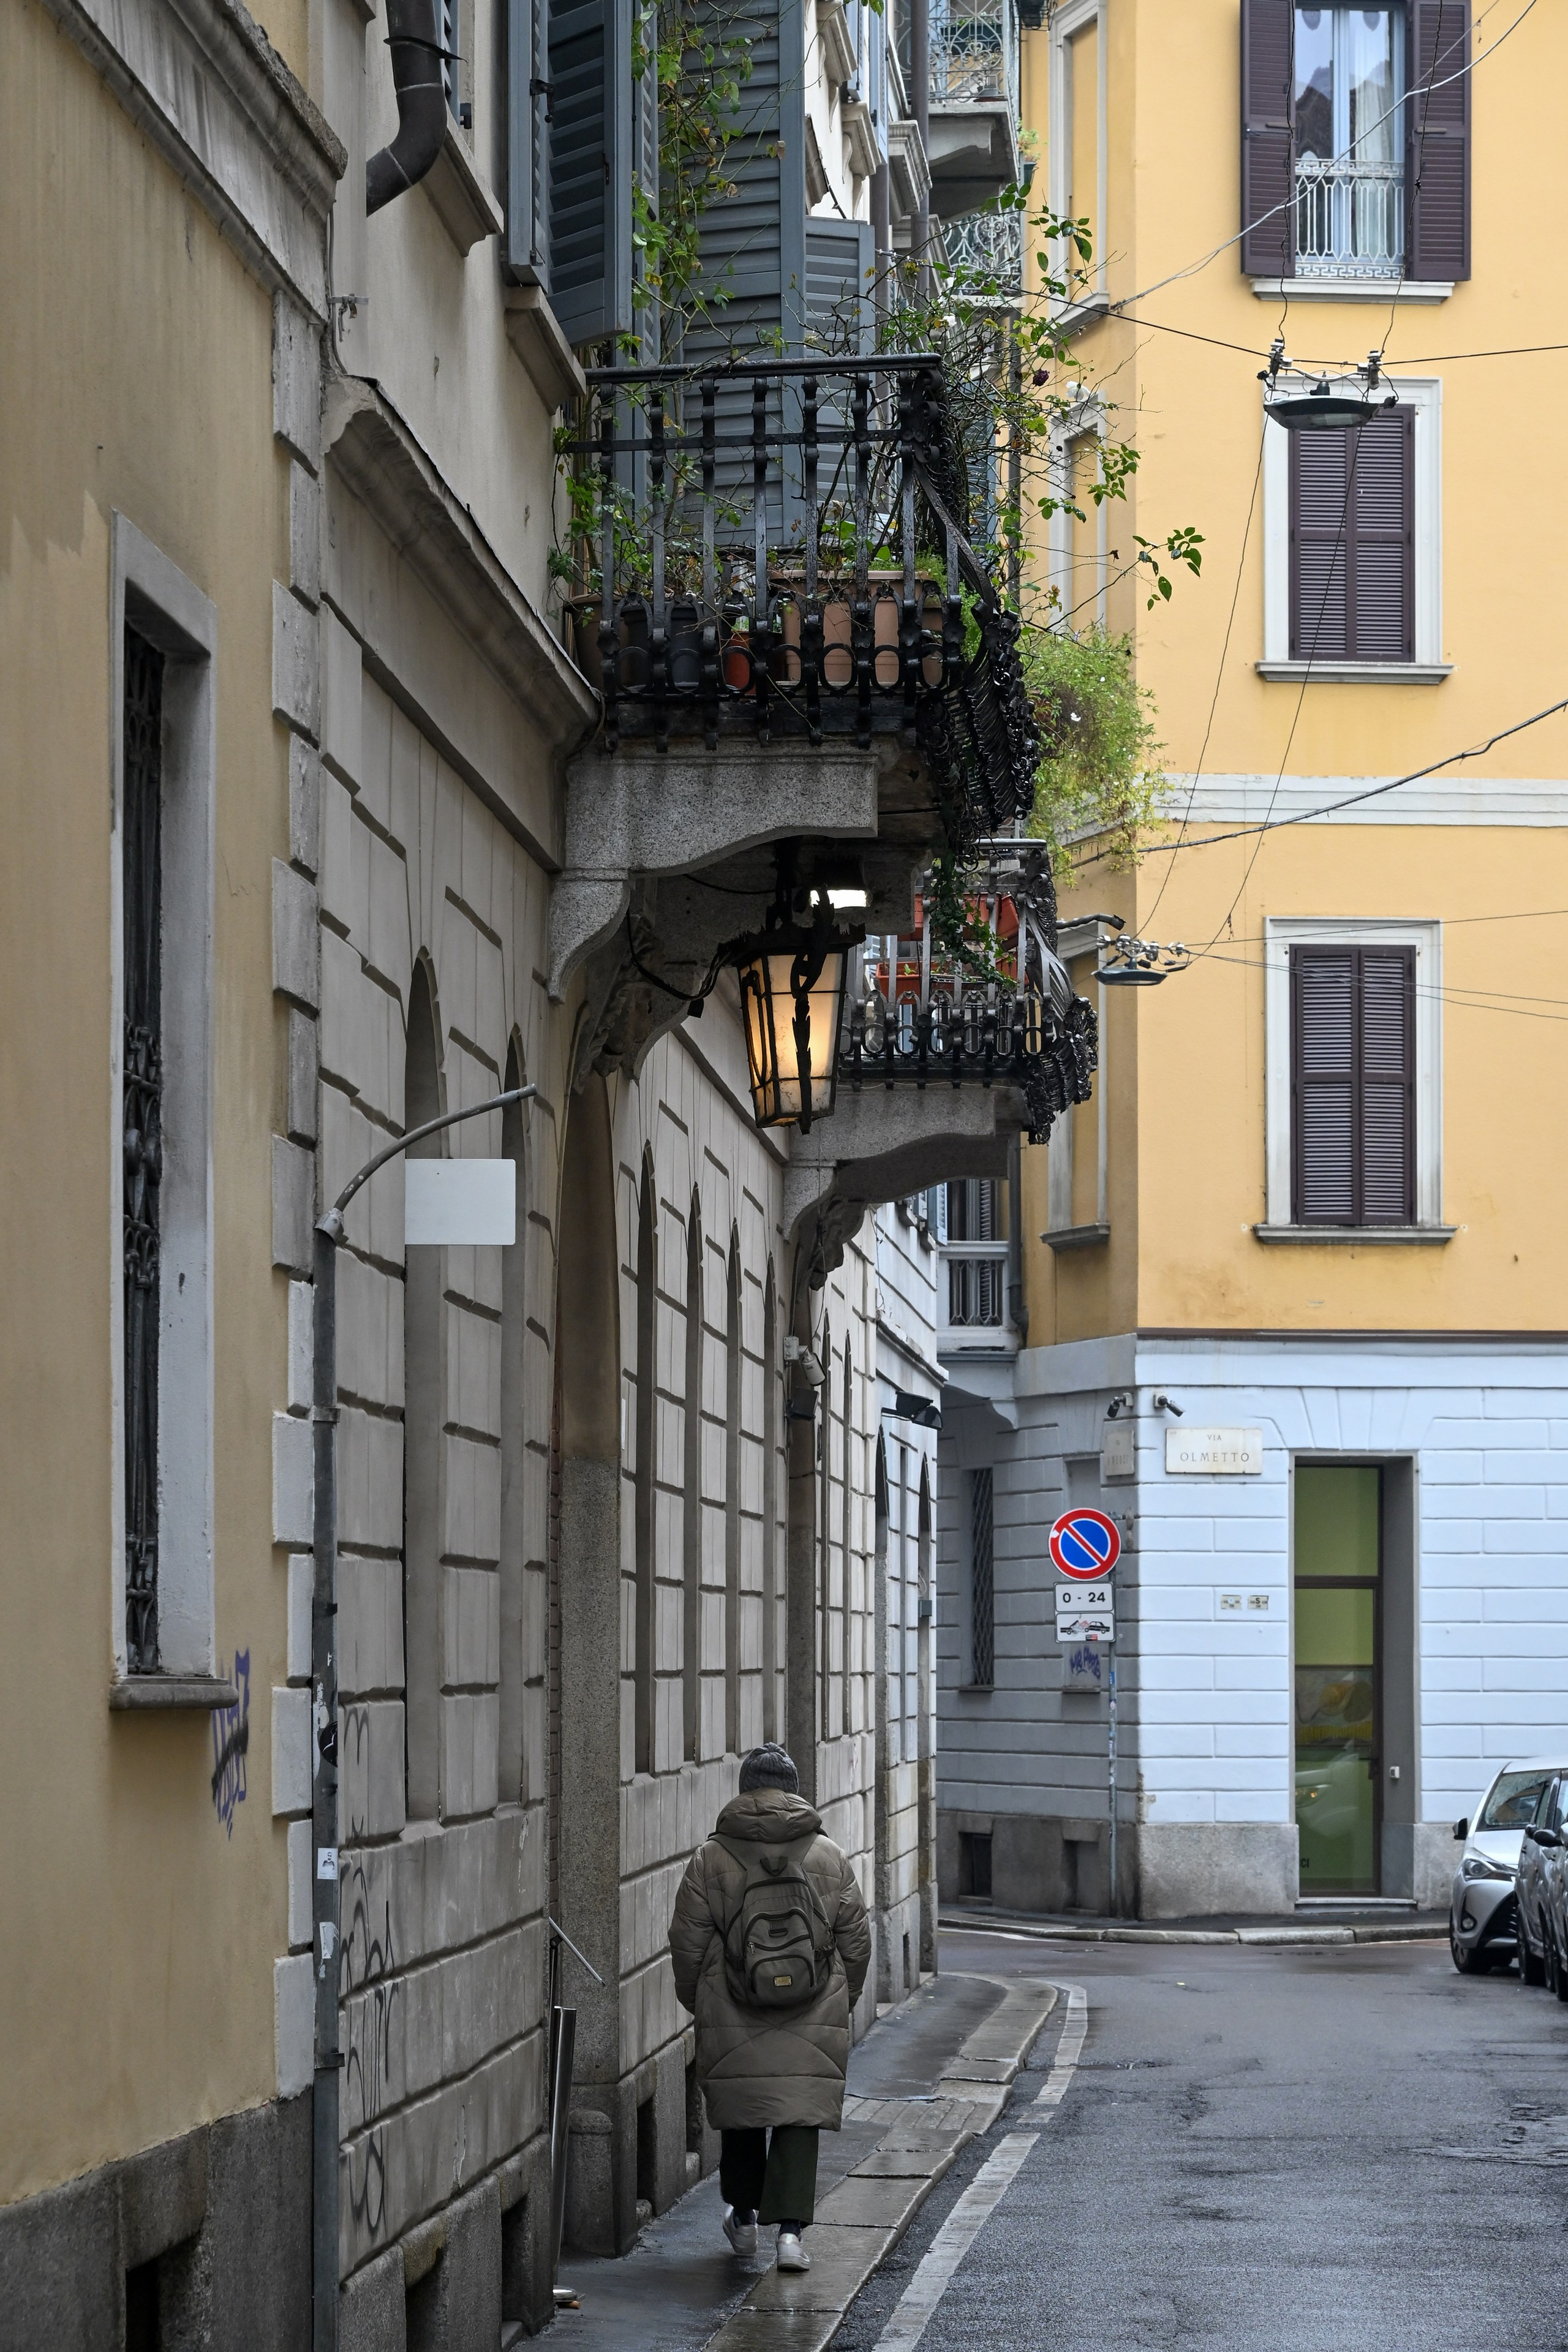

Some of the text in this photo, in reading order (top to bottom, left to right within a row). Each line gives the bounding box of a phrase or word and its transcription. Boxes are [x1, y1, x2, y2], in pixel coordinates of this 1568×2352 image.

[1180, 1452, 1250, 1463] OLMETTO
[1063, 1593, 1071, 1603] 0
[1088, 1592, 1106, 1603] 24
